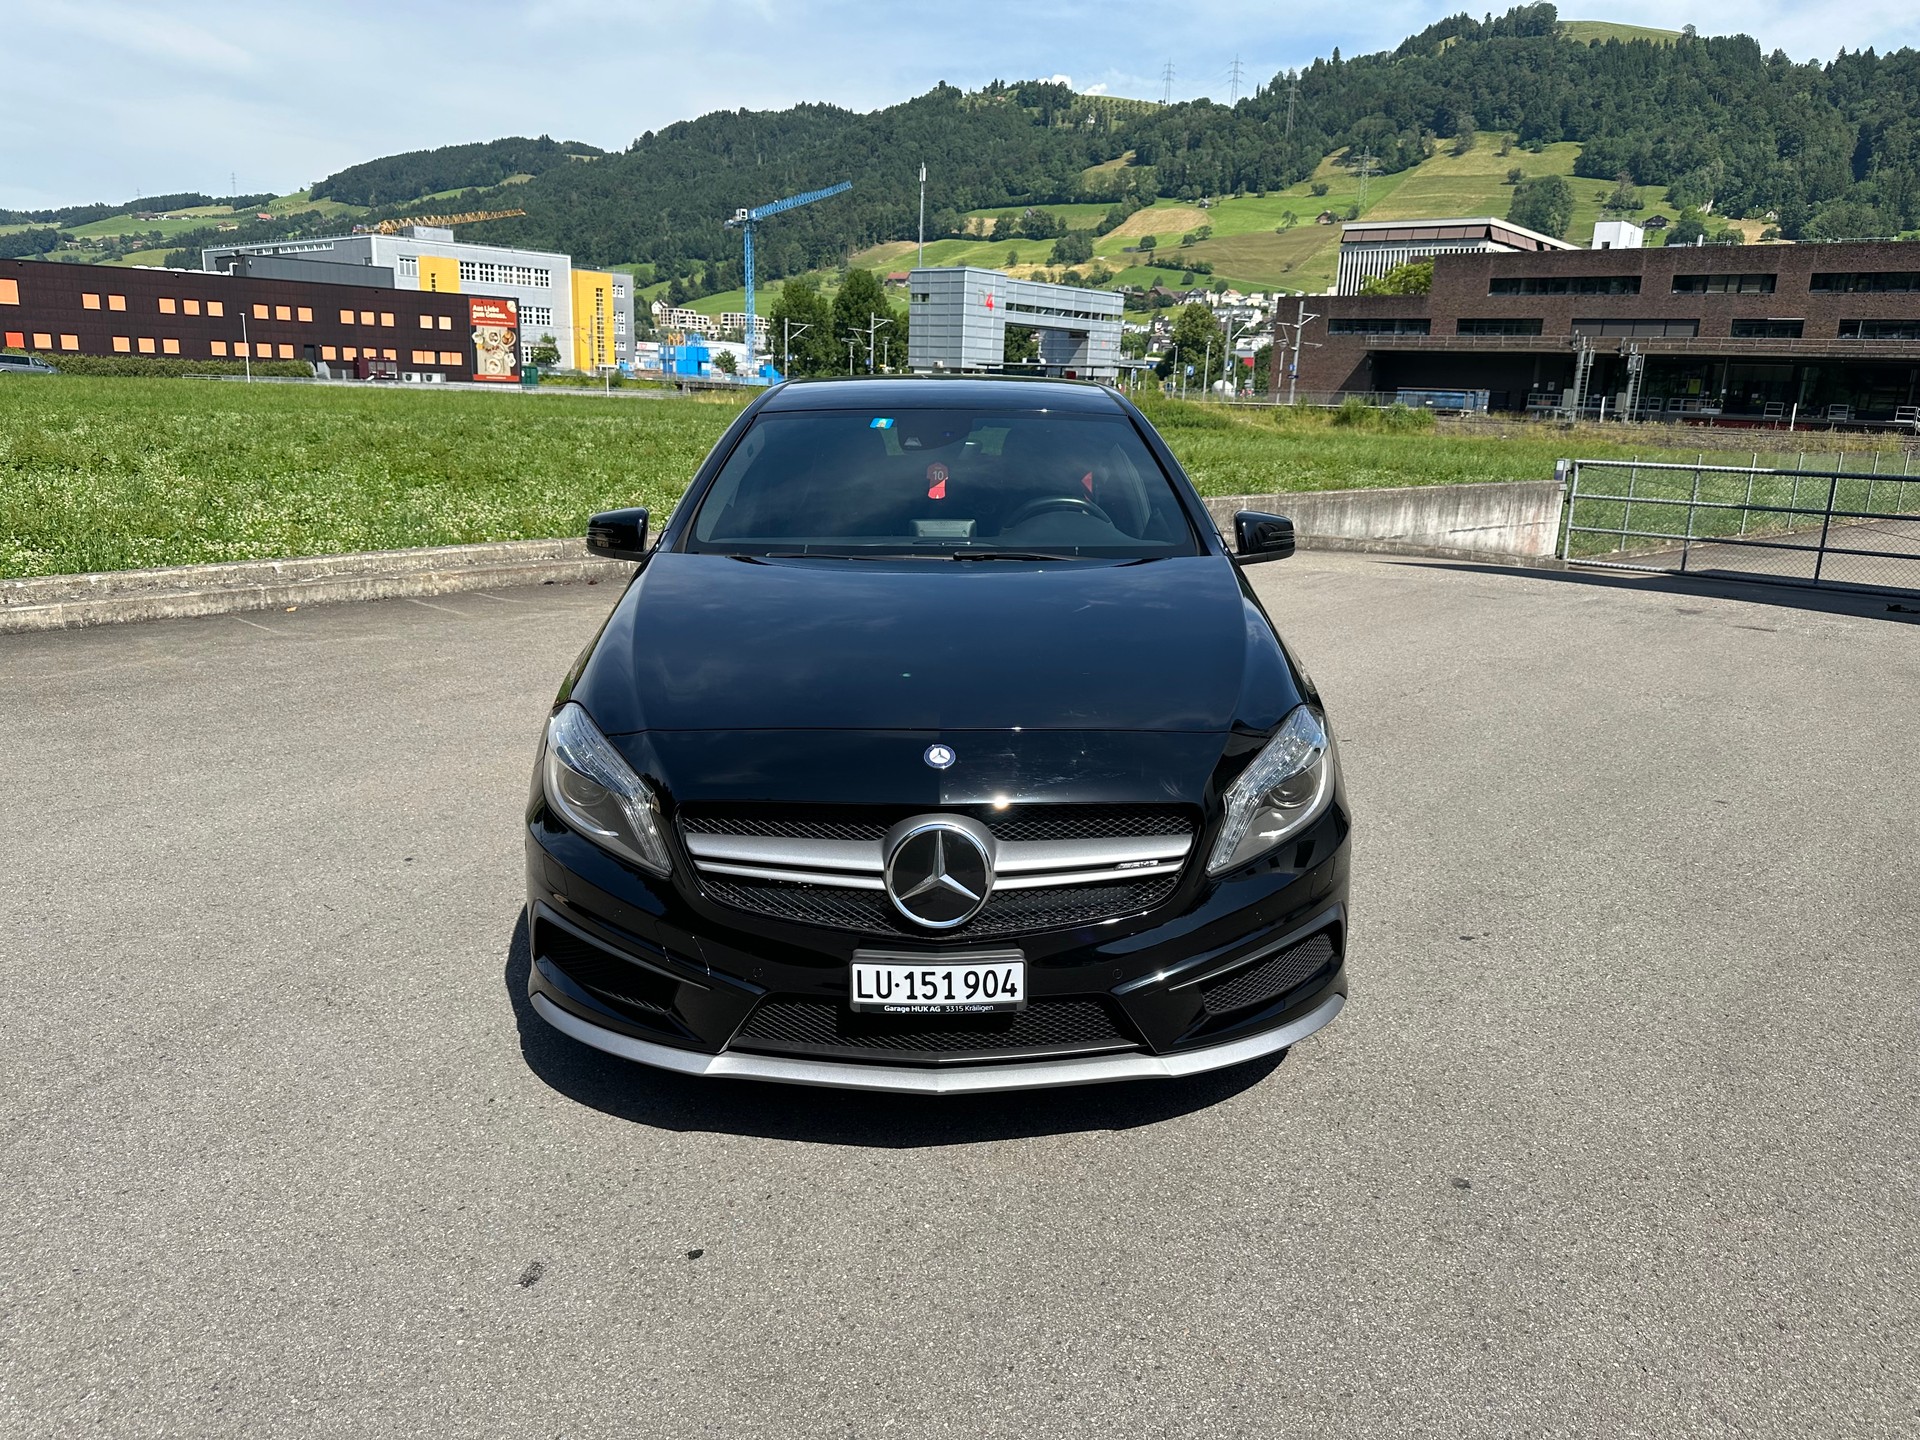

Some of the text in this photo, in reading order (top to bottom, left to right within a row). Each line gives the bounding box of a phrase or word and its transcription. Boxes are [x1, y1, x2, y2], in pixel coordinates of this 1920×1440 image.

[932, 470, 944, 480] 10
[884, 1005, 910, 1013] Garage
[945, 1005, 964, 1013] 3315
